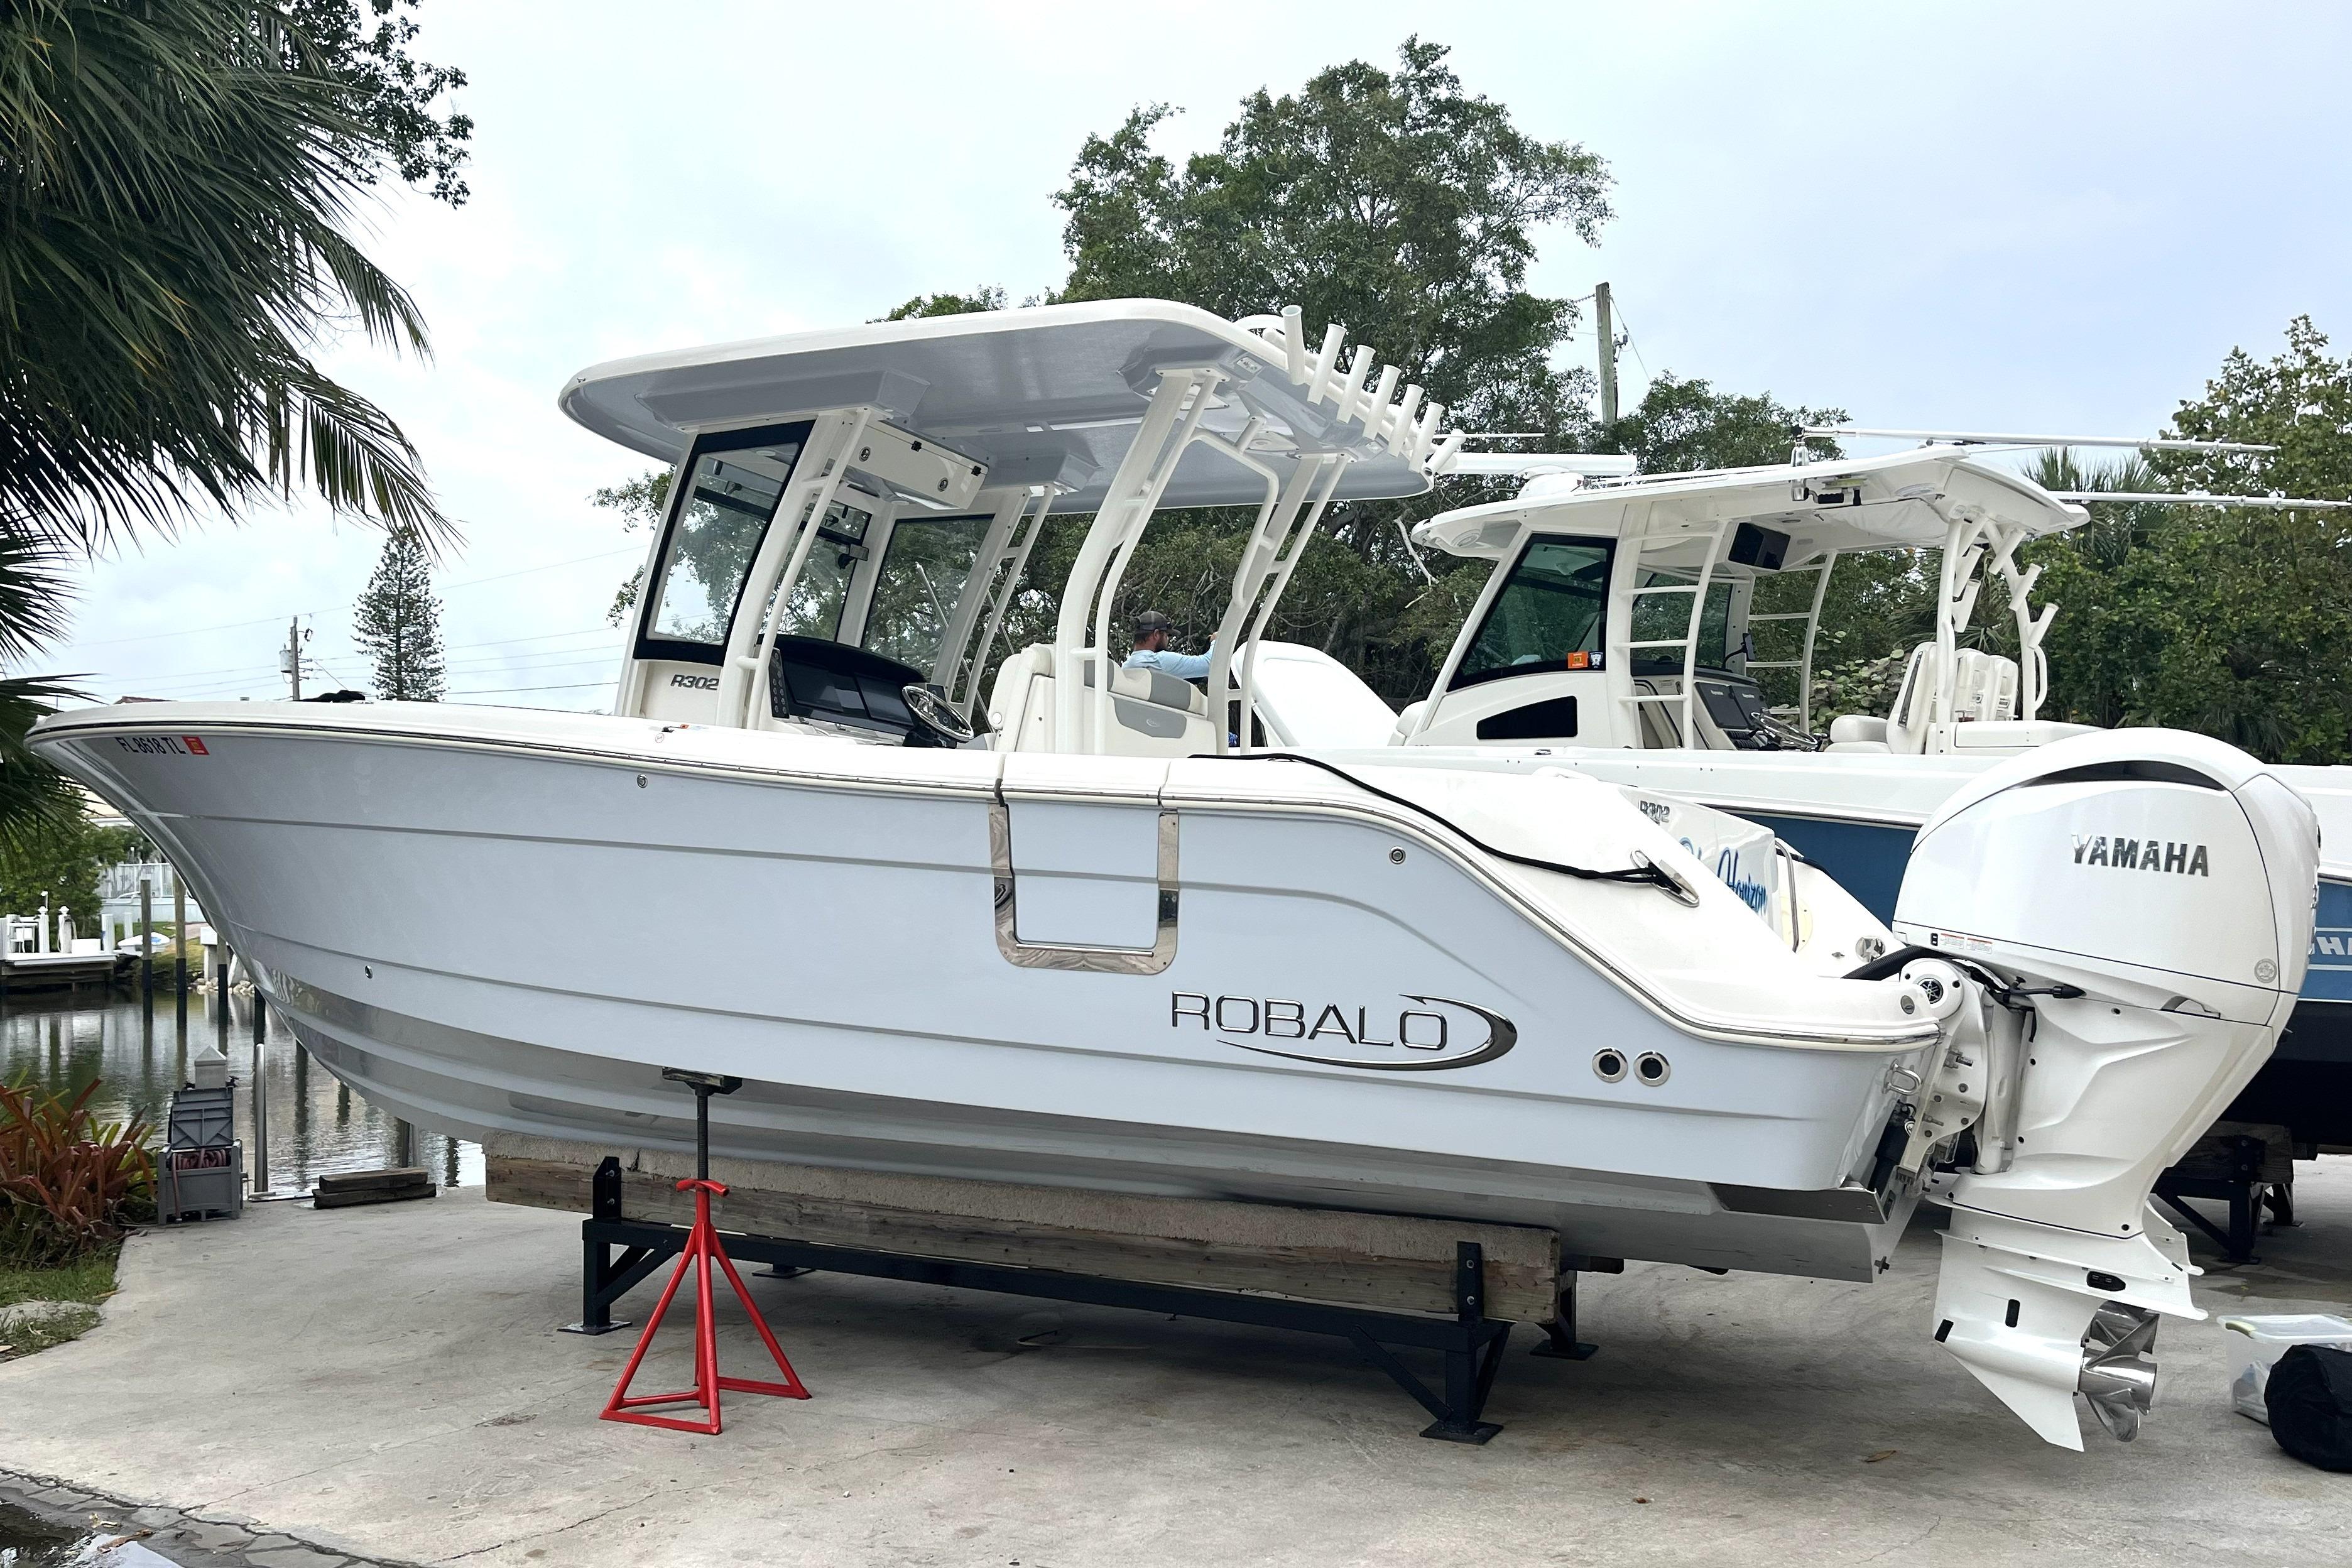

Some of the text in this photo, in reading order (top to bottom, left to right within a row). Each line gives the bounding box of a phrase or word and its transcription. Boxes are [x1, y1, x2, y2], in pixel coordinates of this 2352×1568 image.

[670, 674, 719, 690] R302
[115, 737, 138, 753] FL
[132, 737, 166, 754] 8618
[160, 737, 186, 754] TL
[2071, 834, 2209, 877] YAMAHA
[1172, 990, 1447, 1051] ROBALO
